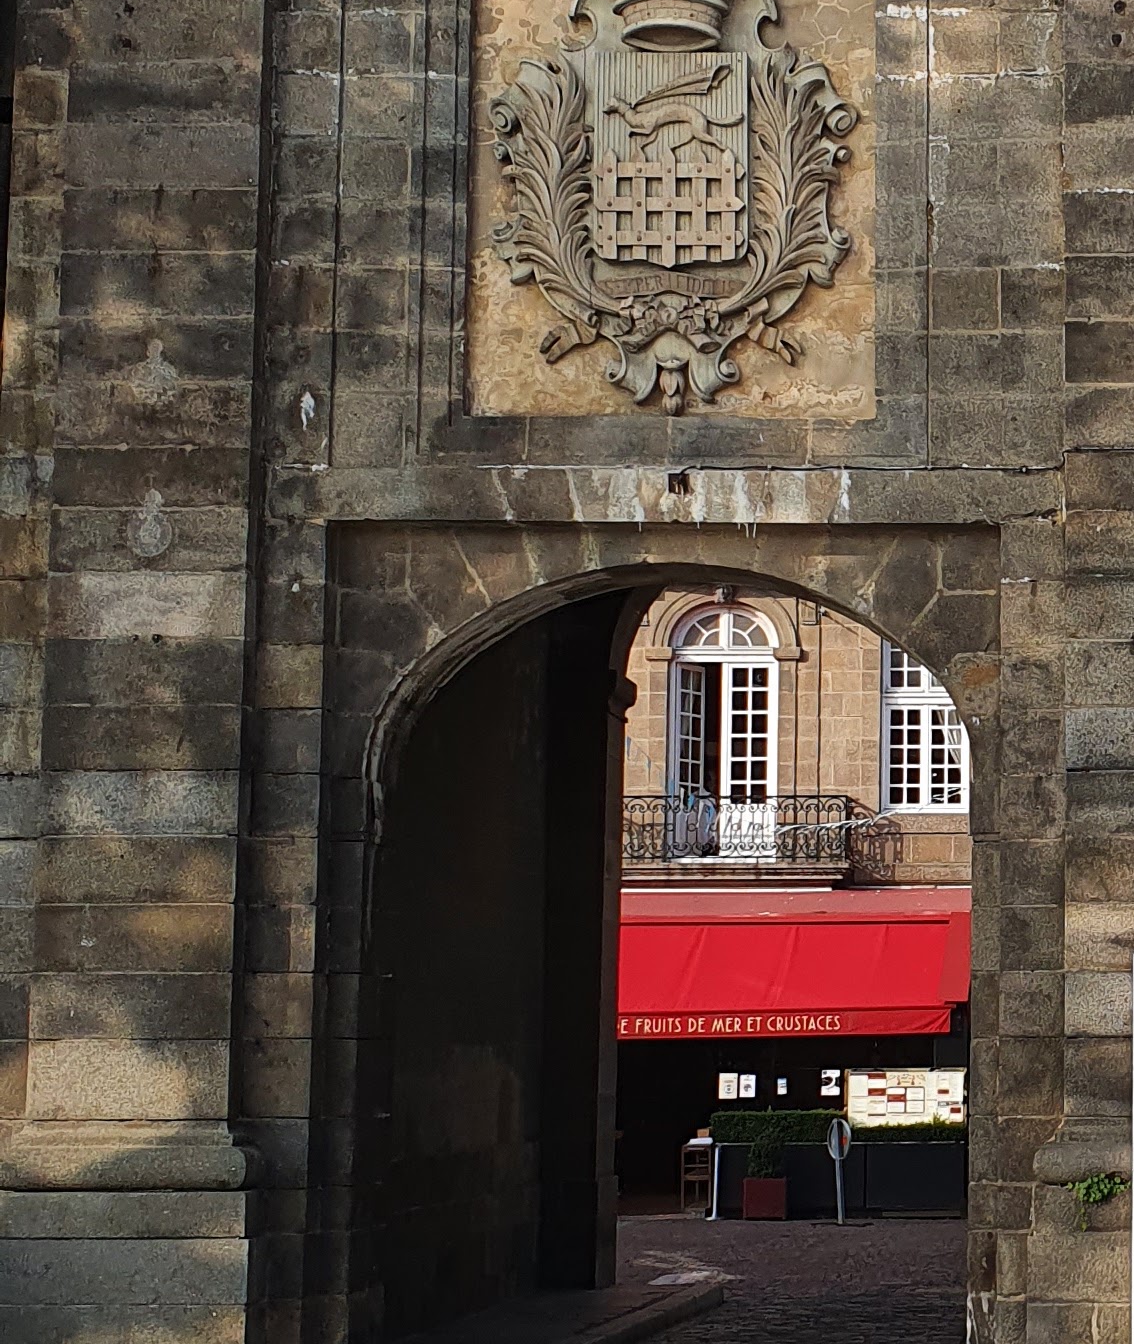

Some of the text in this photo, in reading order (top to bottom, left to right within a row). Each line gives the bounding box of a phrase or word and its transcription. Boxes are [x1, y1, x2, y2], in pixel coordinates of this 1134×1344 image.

[617, 1015, 841, 1034] E FRUITS DE MER ET CRUSTACES
